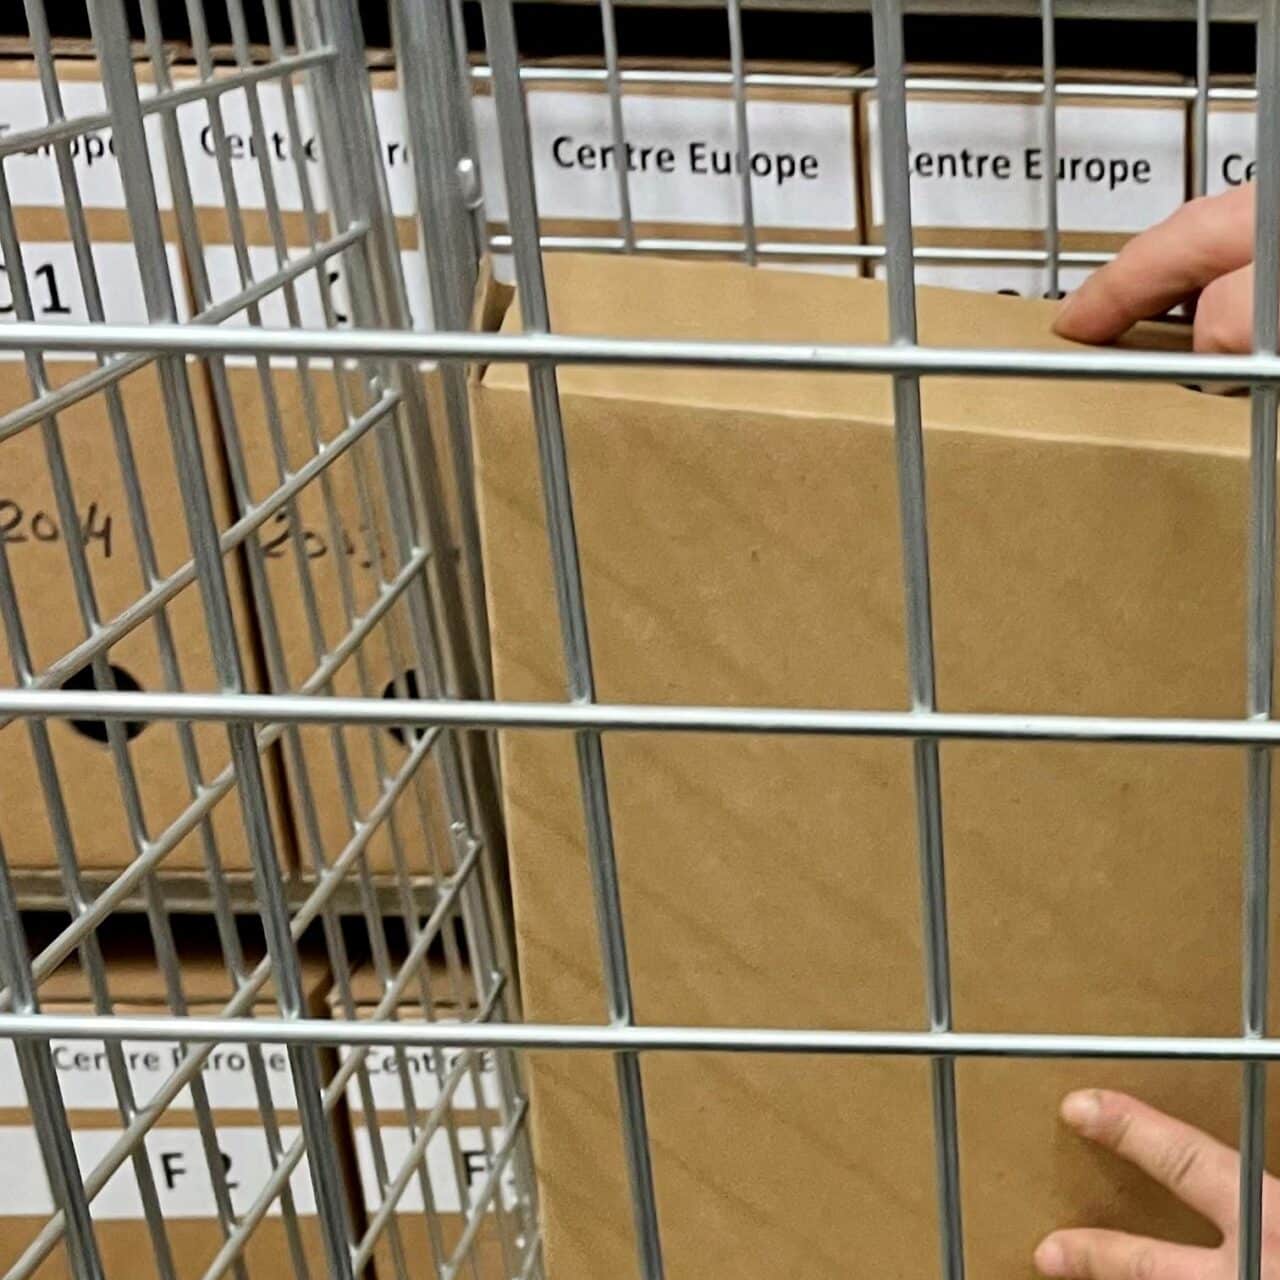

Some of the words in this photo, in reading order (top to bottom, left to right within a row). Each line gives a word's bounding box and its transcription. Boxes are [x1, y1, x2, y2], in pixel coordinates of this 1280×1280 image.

[689, 142, 820, 185] Euope
[908, 148, 1011, 180] entre
[52, 1046, 160, 1071] Cenre
[173, 1046, 286, 1073] Eroe
[161, 1152, 186, 1190] F
